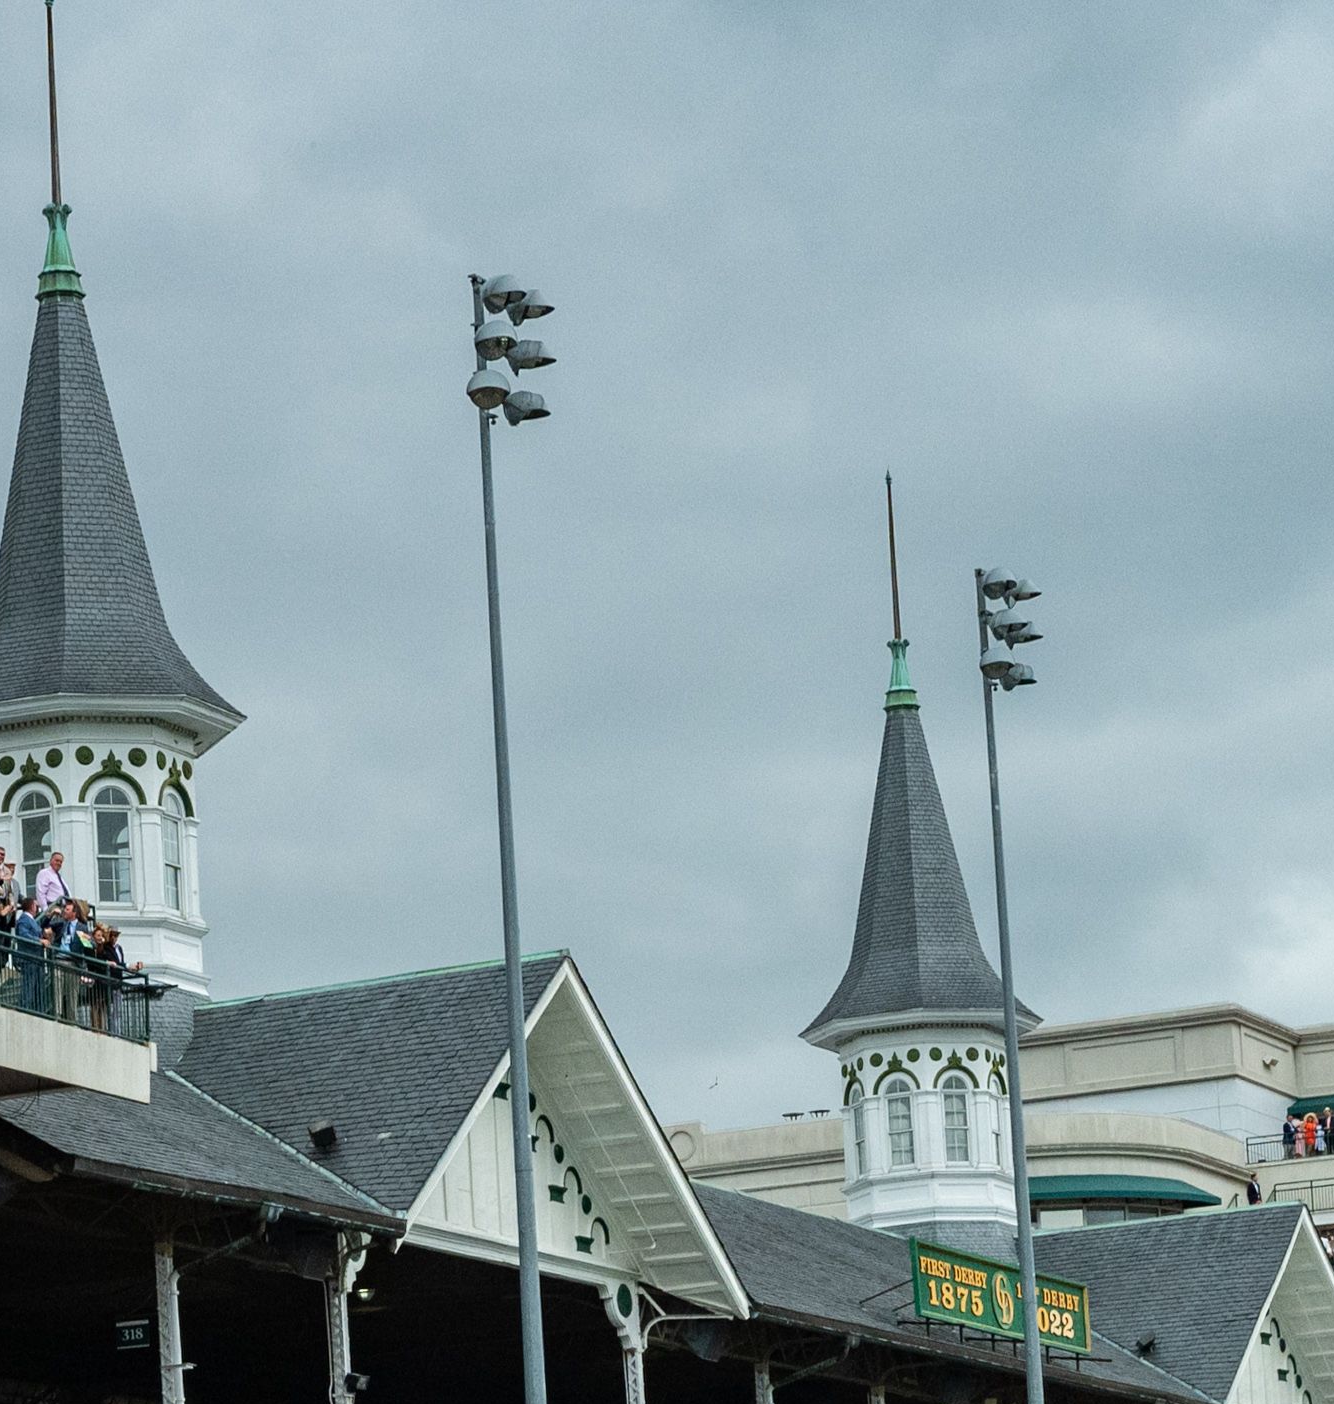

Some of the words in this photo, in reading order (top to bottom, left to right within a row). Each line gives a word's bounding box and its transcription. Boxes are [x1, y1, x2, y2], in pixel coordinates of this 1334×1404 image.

[919, 1255, 951, 1279] FIRST
[953, 1265, 987, 1289] DERBY
[928, 1280, 984, 1317] 1875
[1043, 1287, 1080, 1312] DERBY
[122, 1328, 144, 1341] 318
[1037, 1307, 1075, 1339] 022
